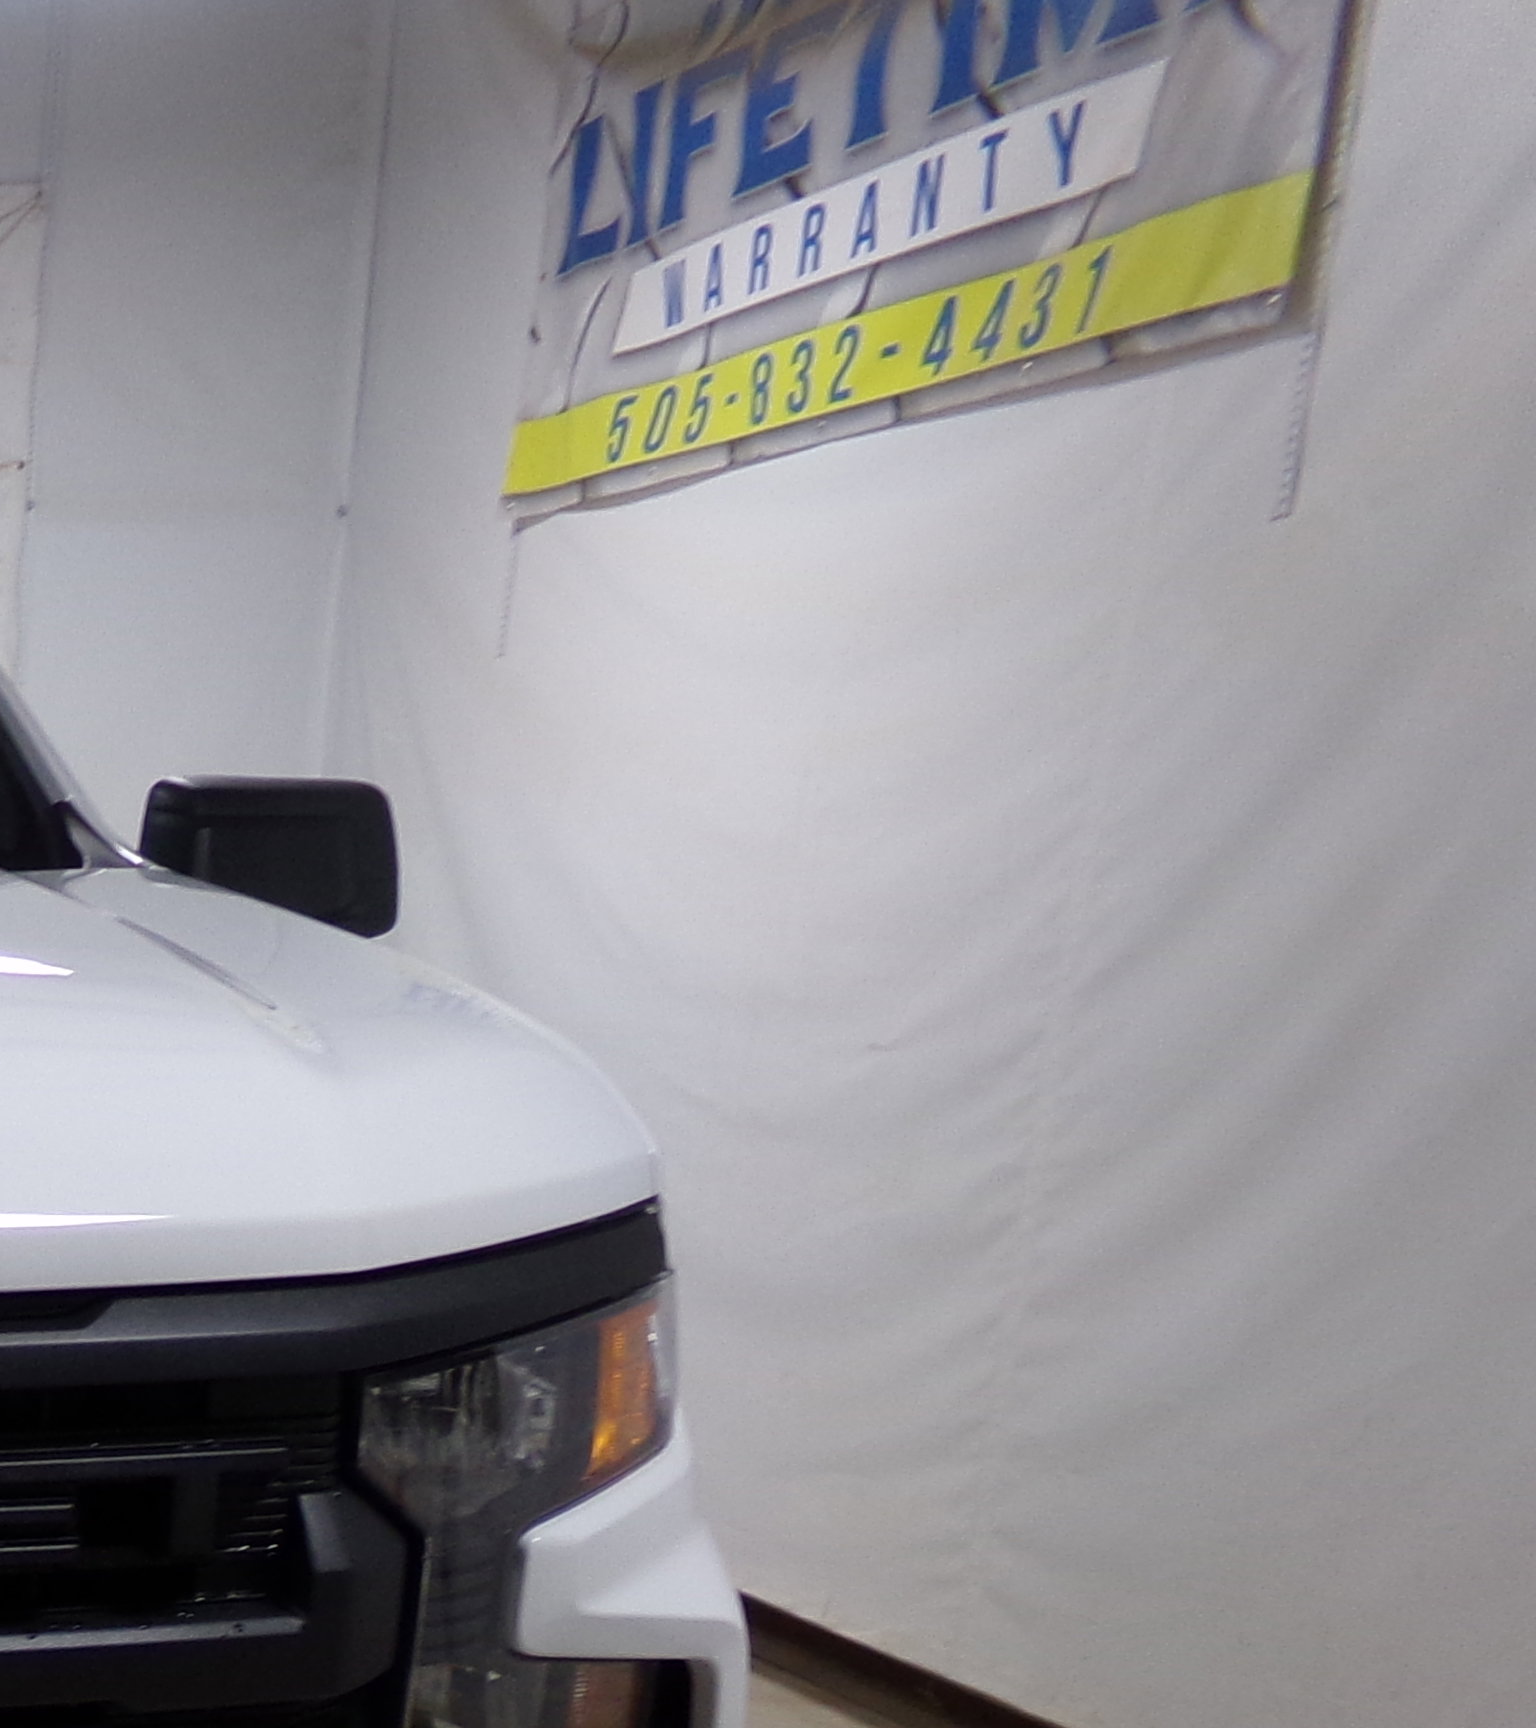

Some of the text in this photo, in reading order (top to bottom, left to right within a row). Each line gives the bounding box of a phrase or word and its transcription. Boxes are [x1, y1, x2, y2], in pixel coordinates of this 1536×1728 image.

[557, 0, 1216, 278] LIFETIM
[662, 100, 1086, 330] WARRANTY
[606, 244, 1117, 464] 505-832-4431
